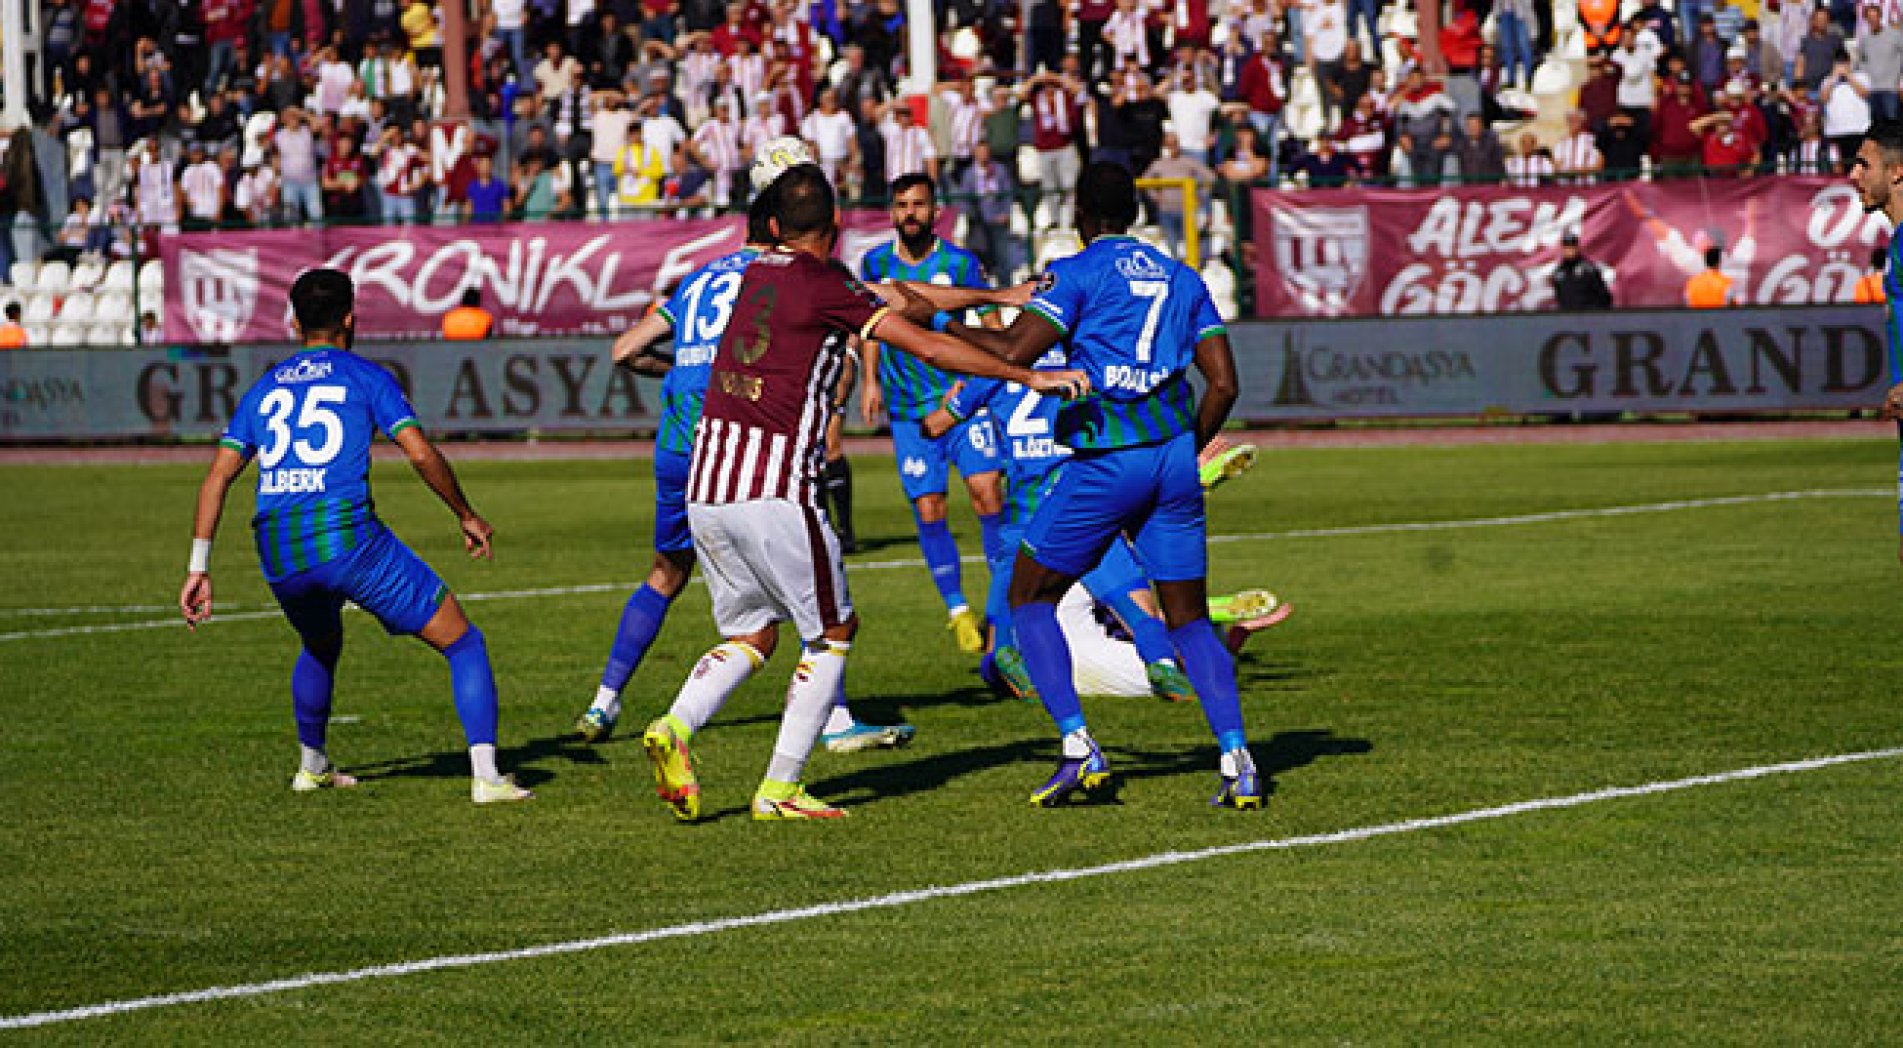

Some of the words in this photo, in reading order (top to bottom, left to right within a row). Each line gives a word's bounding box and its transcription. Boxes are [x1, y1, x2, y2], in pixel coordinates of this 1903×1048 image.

[683, 271, 742, 343] 13
[733, 283, 776, 364] 3
[1129, 280, 1168, 362] 7
[445, 356, 648, 419] ASYA
[1540, 325, 1884, 399] GRAND
[258, 386, 347, 469] 35
